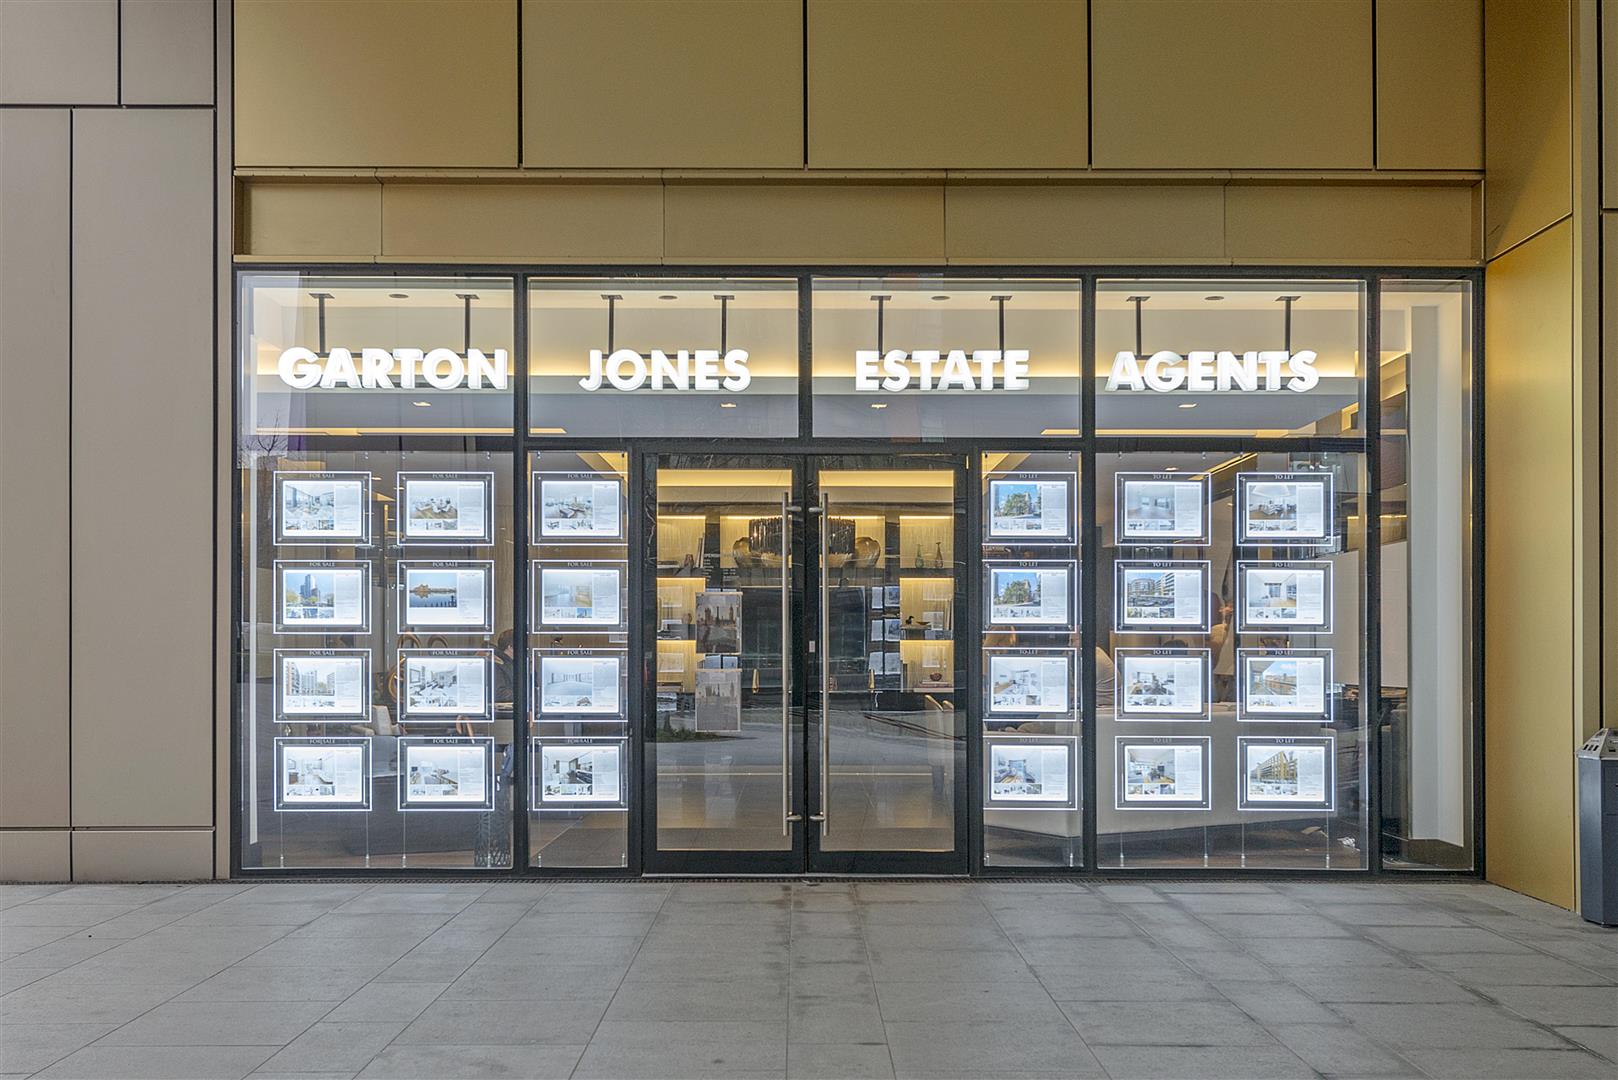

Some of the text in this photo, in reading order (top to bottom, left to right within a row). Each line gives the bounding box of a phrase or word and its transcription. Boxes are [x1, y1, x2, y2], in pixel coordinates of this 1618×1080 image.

[278, 347, 1320, 393] GARTON JONES ESTATE AGENTS
